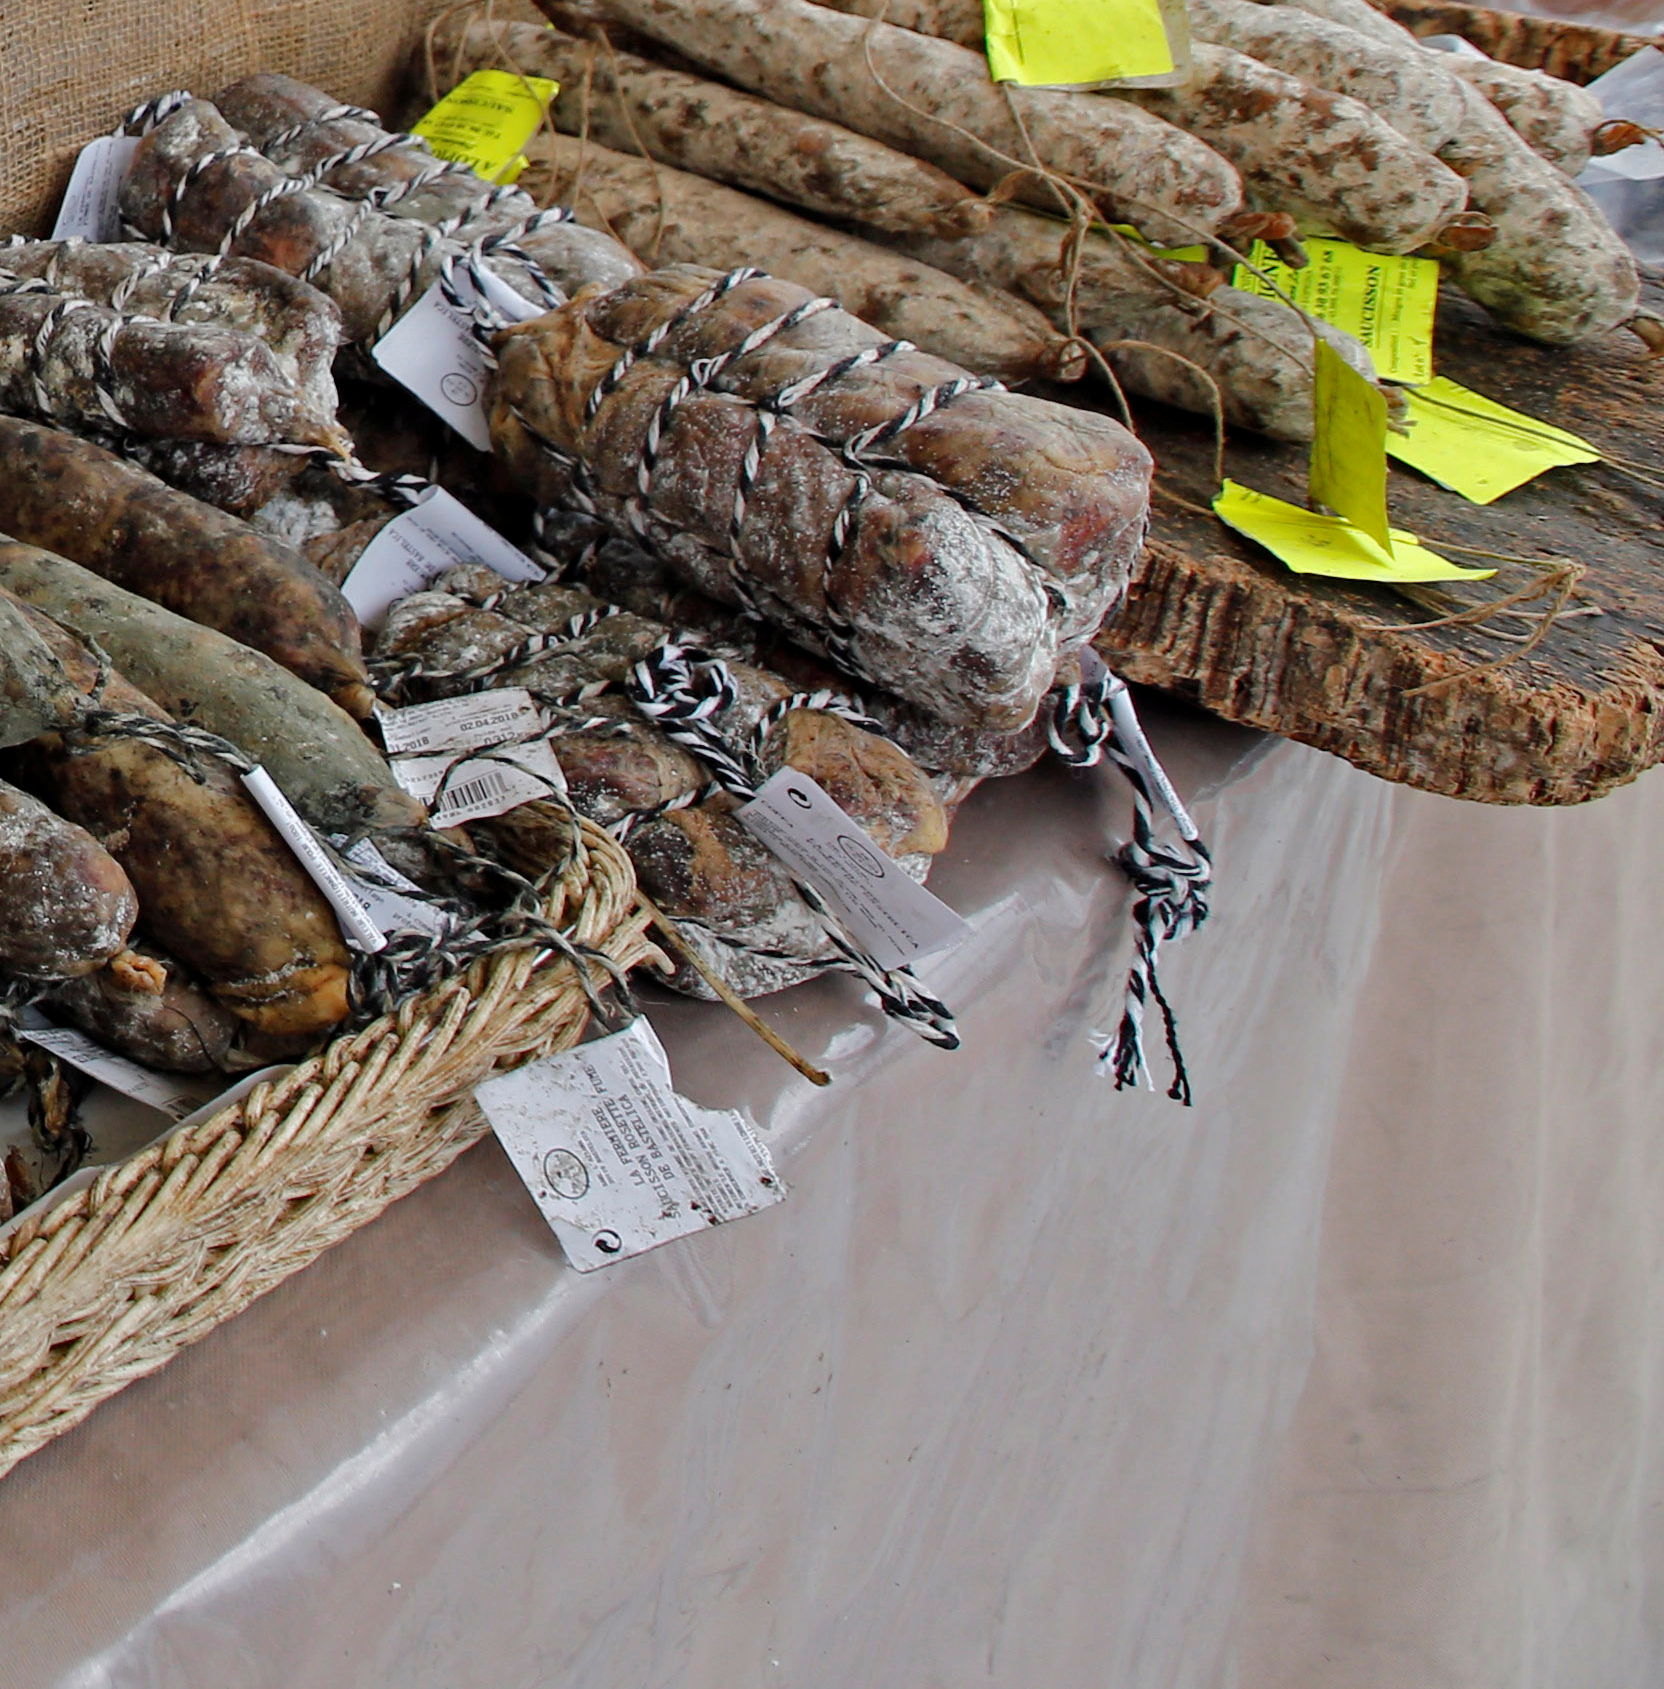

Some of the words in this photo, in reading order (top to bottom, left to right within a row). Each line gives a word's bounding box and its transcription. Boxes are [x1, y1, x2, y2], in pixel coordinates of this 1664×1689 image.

[1360, 264, 1380, 347] SAUCISSON
[590, 1104, 633, 1166] FERMIERE
[602, 1096, 641, 1151] ROSETTE
[616, 1093, 663, 1160] BASTELICA
[628, 1168, 645, 1187] LA
[635, 1152, 682, 1221] SAUCISSON
[658, 1162, 675, 1181] DE
